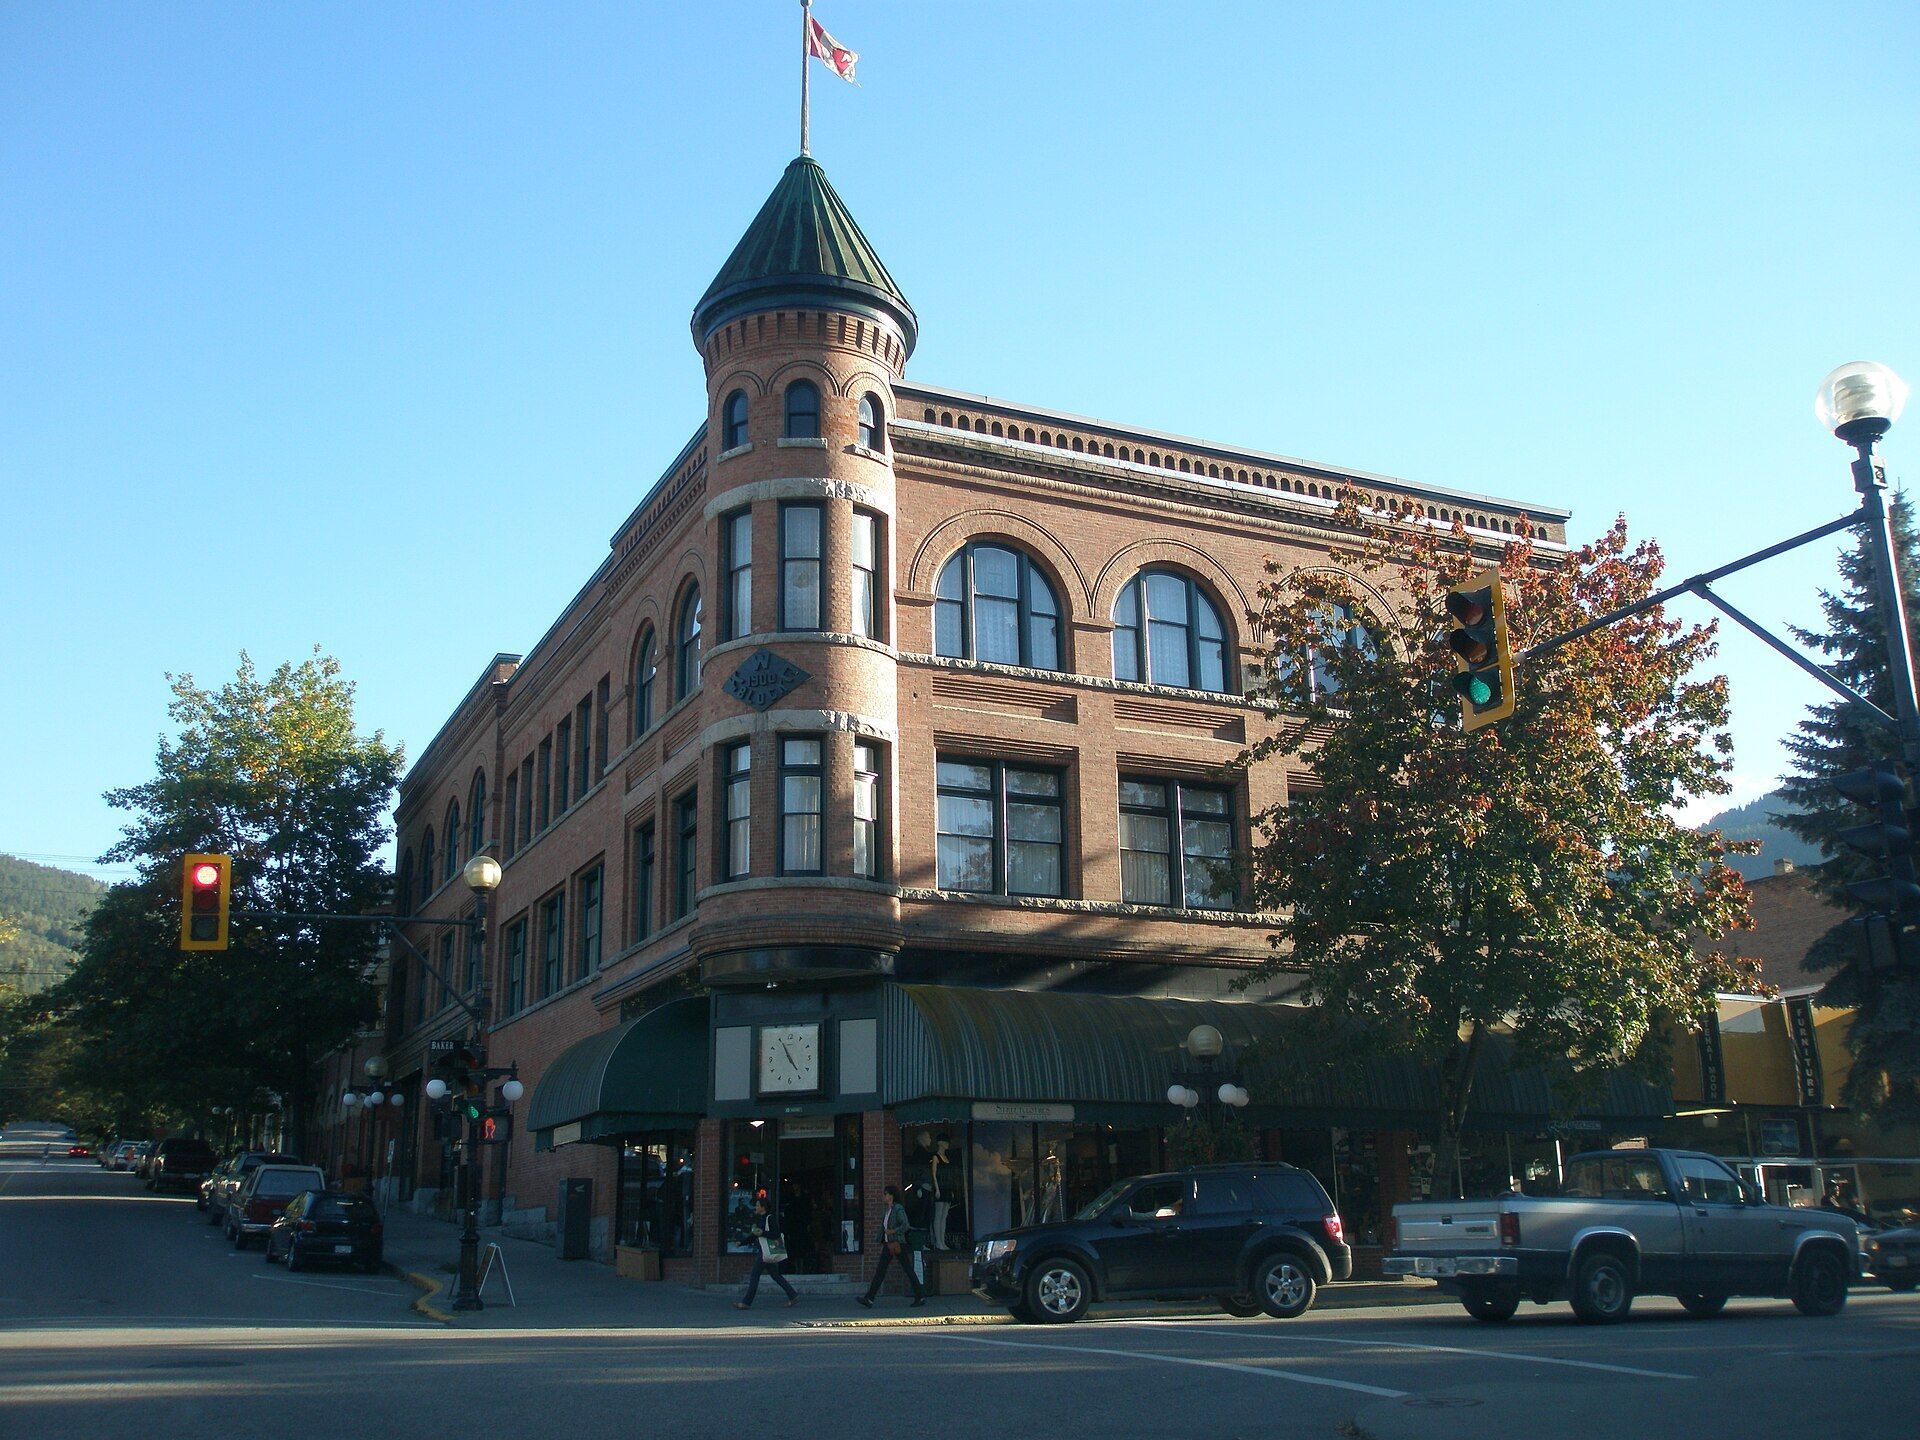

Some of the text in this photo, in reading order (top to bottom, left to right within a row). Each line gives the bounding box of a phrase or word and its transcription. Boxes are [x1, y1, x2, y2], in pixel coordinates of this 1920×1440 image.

[752, 654, 772, 671] W
[748, 673, 778, 688] 1900
[737, 680, 787, 705] BLOCK
[431, 1041, 454, 1050] BAKER
[1796, 1009, 1816, 1097] FURNITURE
[1708, 1066, 1717, 1099] MOON
